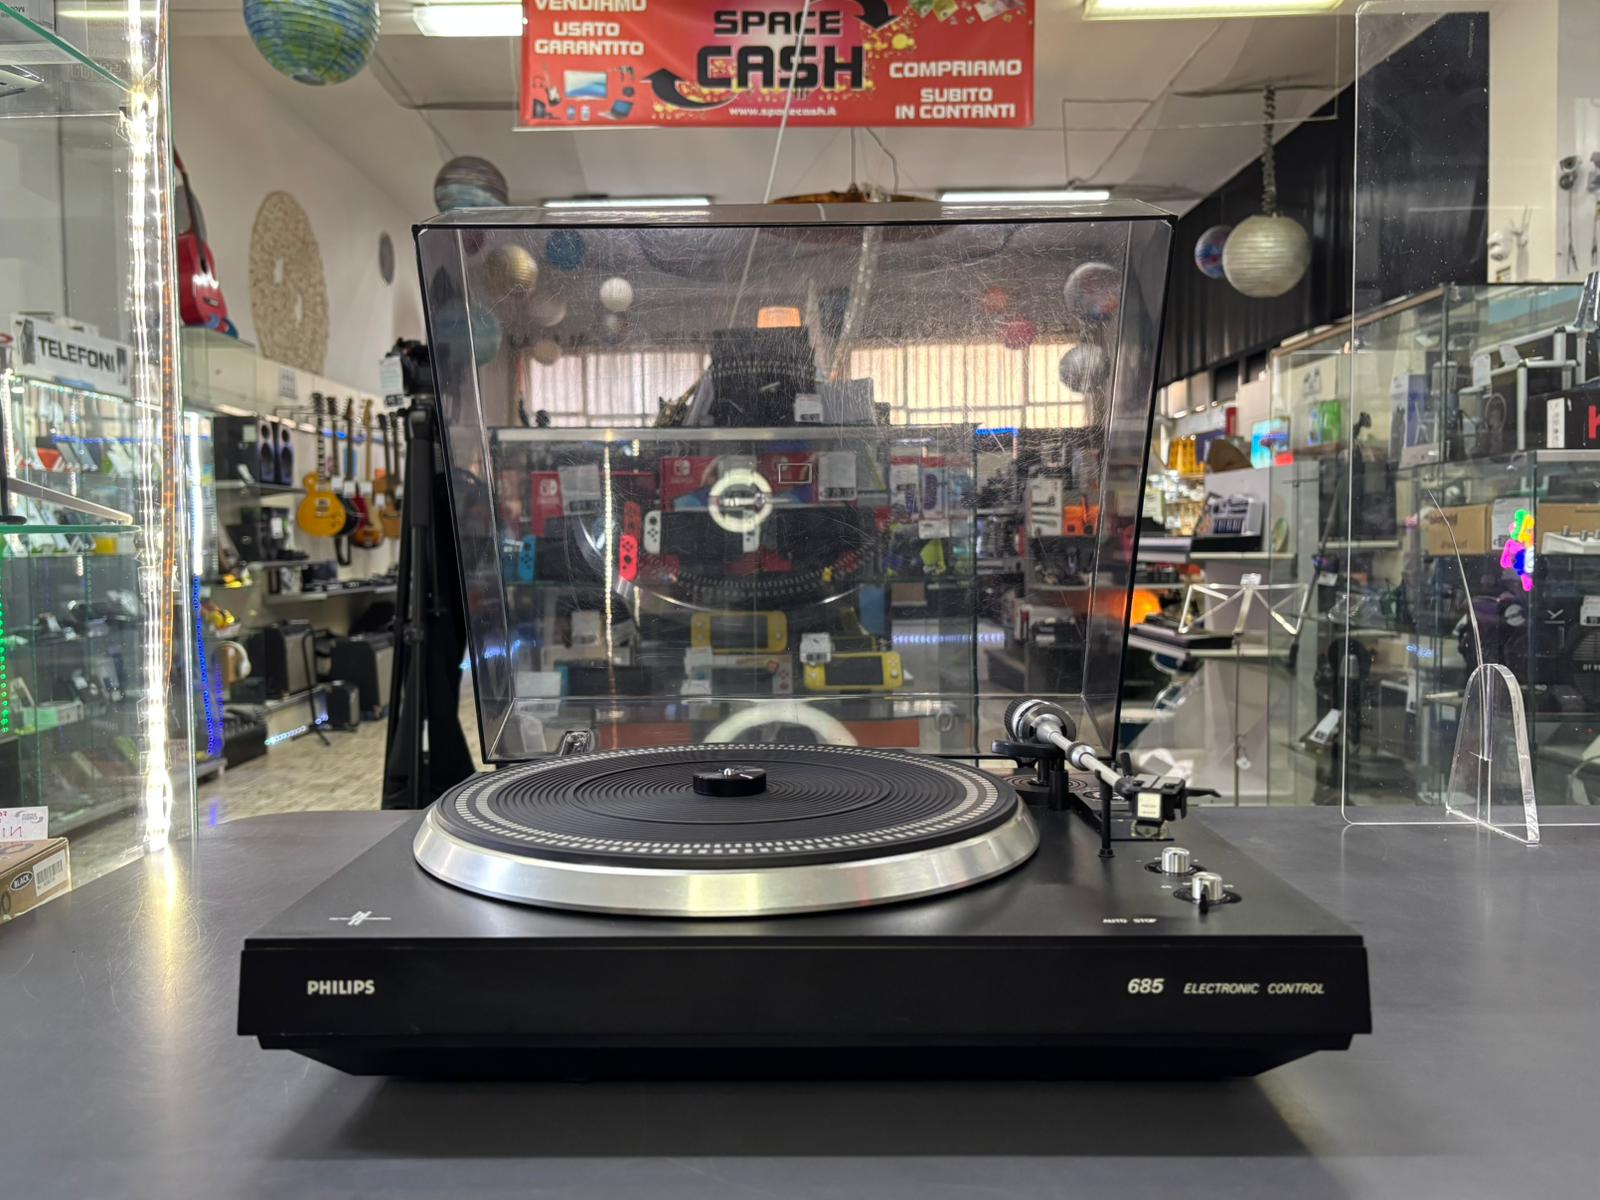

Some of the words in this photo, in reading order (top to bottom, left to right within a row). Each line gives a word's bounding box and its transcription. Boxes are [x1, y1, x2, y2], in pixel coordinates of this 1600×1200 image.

[535, 0, 647, 12] VENDIAMO
[553, 21, 621, 37] USATO
[714, 11, 841, 35] SPACE
[534, 39, 645, 56] GARANTITO
[697, 46, 863, 89] CASH
[889, 59, 1023, 79] COMPRIAMO
[920, 87, 993, 103] SUBITO
[895, 105, 915, 120] IN
[919, 103, 1016, 120] CONTANTI
[38, 336, 115, 373] TELEFONI
[307, 979, 376, 996] PHILIPS
[1127, 978, 1164, 994] 685
[1183, 983, 1260, 995] ELECTRONIC
[1267, 983, 1325, 995] CONTROL
